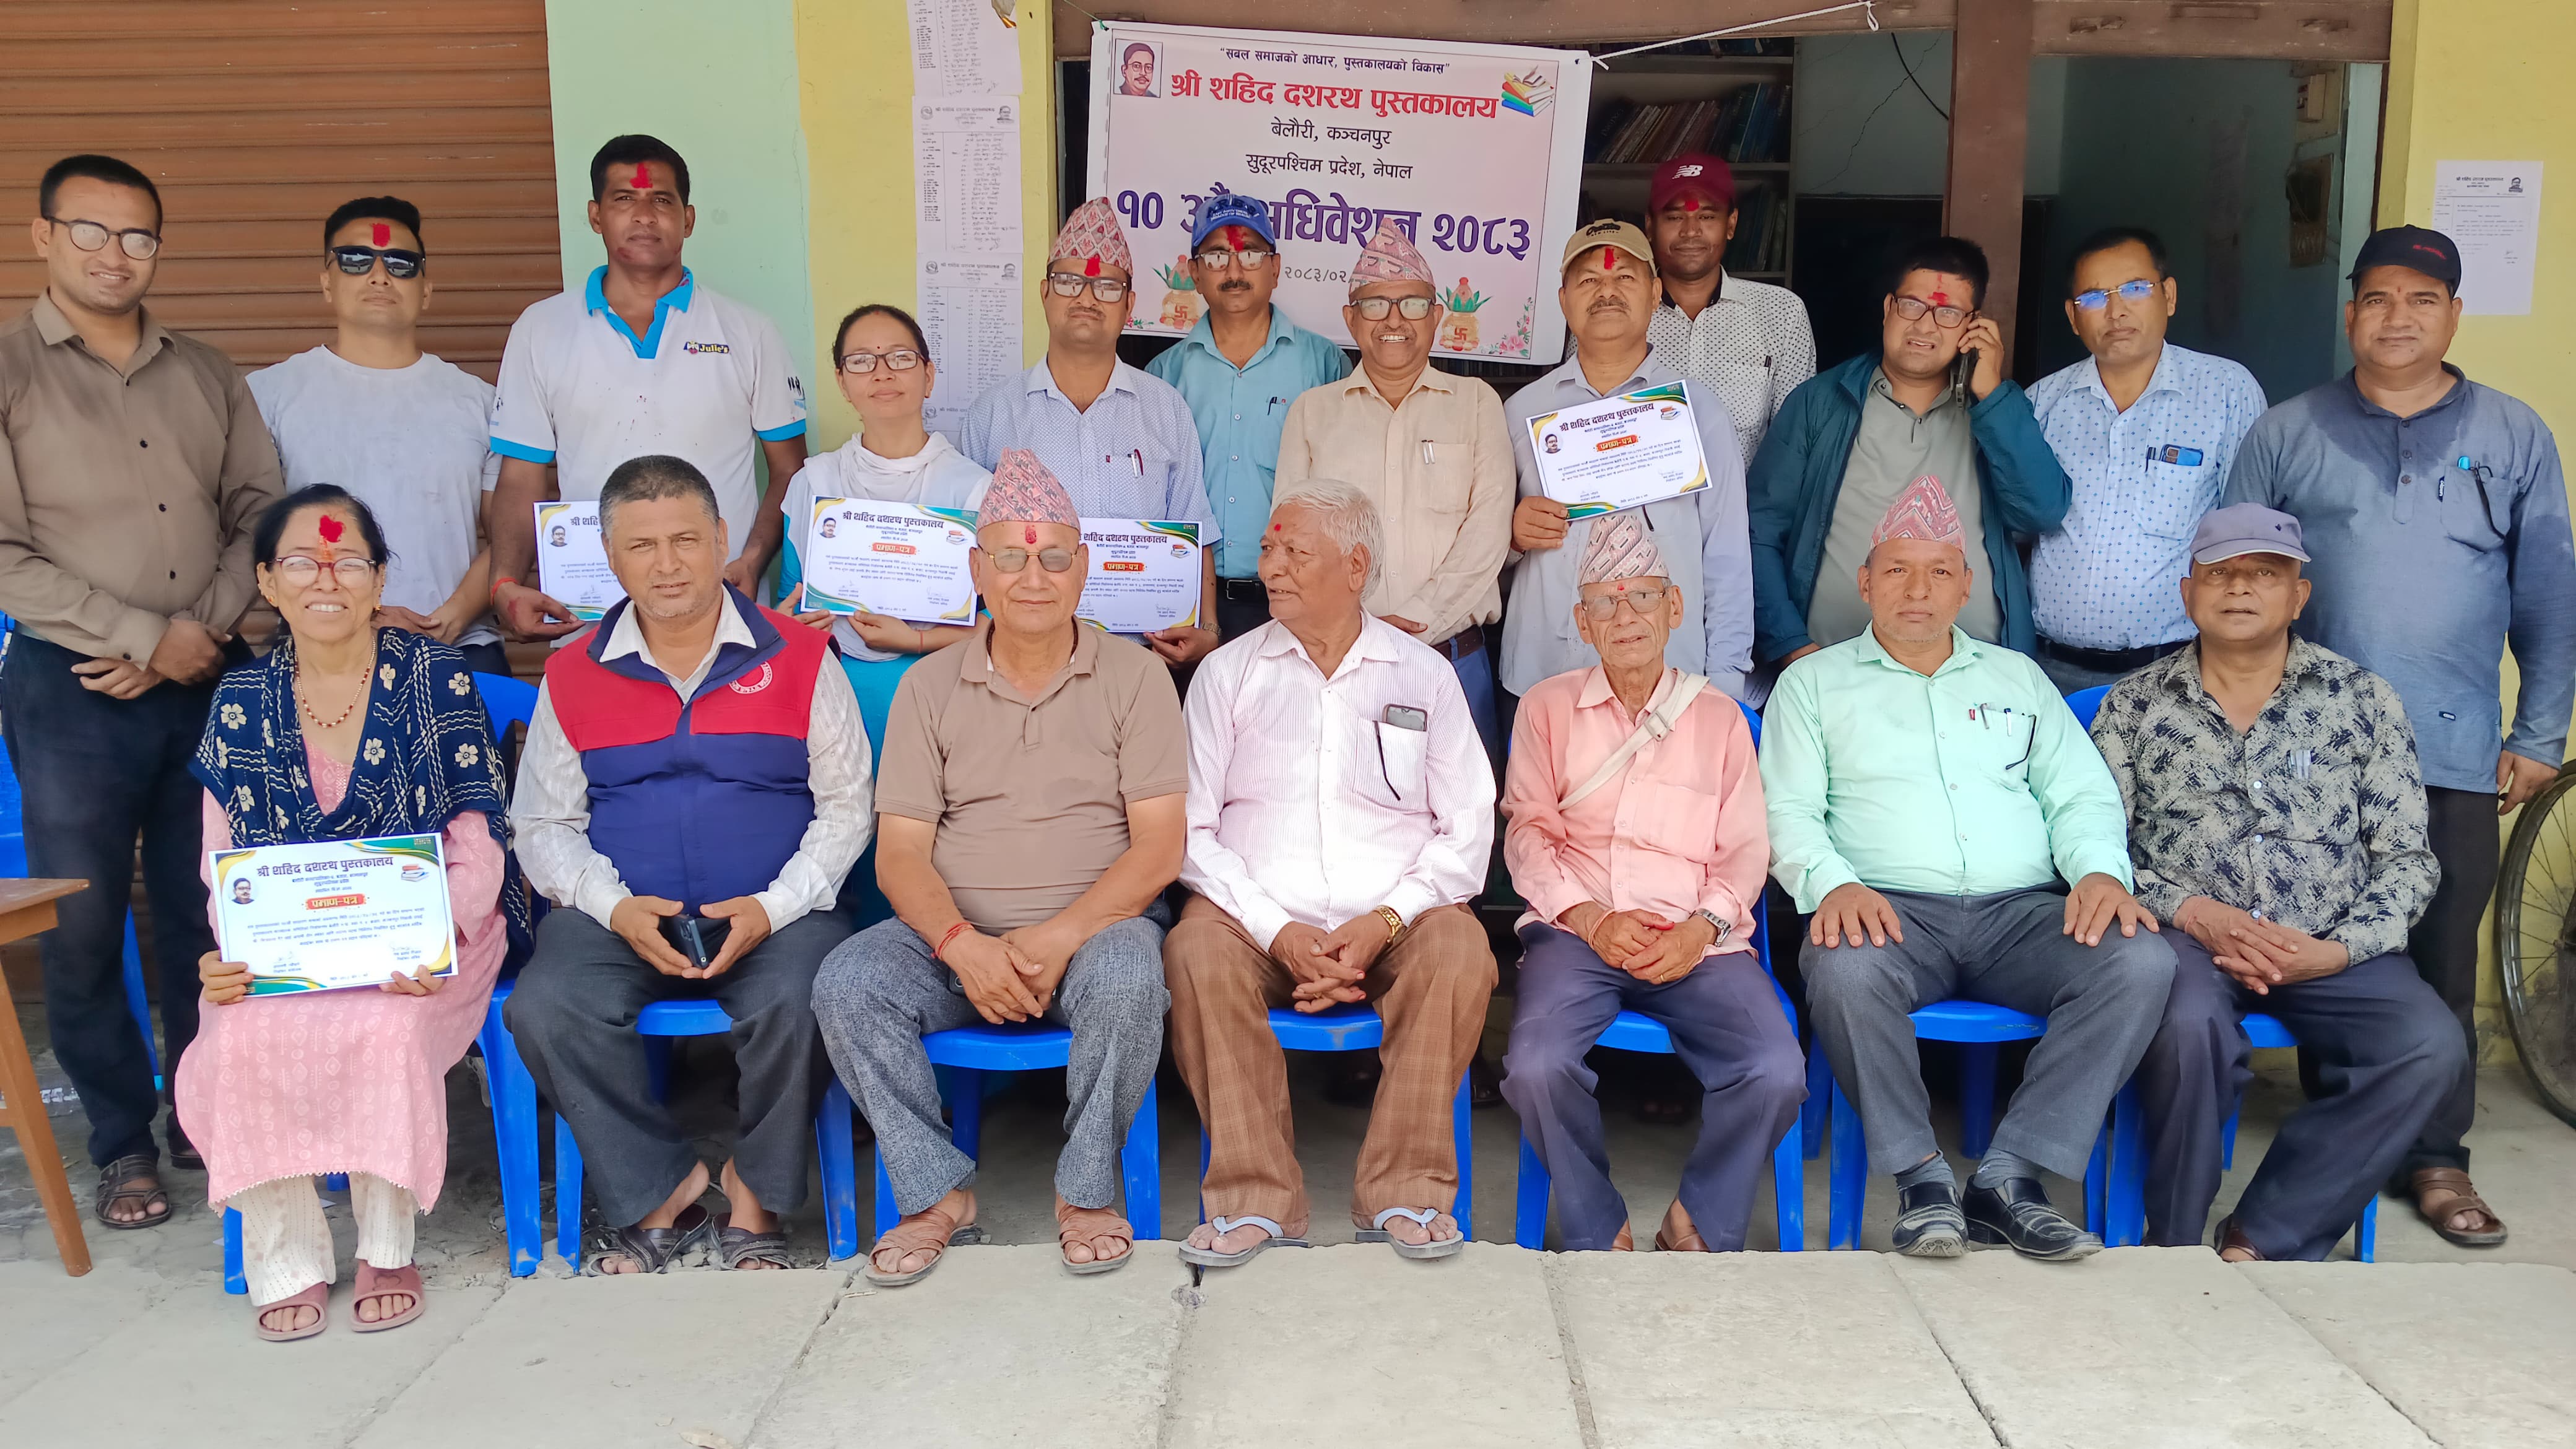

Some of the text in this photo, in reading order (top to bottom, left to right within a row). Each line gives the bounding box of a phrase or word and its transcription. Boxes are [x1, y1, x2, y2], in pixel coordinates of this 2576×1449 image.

[1255, 50, 1298, 64] समाजको
[1303, 53, 1338, 69] आधार,
[1344, 54, 1406, 72] पुस्तकालयको
[1171, 69, 1499, 118] श्री शहिद दशरथ पुस्तकालय
[1271, 116, 1392, 149] बेलौरी, कञ्चनपुर
[1245, 152, 1413, 179] सुदूरपश्चिम प्रदेश, नेपाल
[1116, 189, 1164, 229] १०
[1431, 213, 1531, 261] २०८३
[257, 865, 269, 877] श्री
[340, 856, 394, 872] पुस्तकालय
